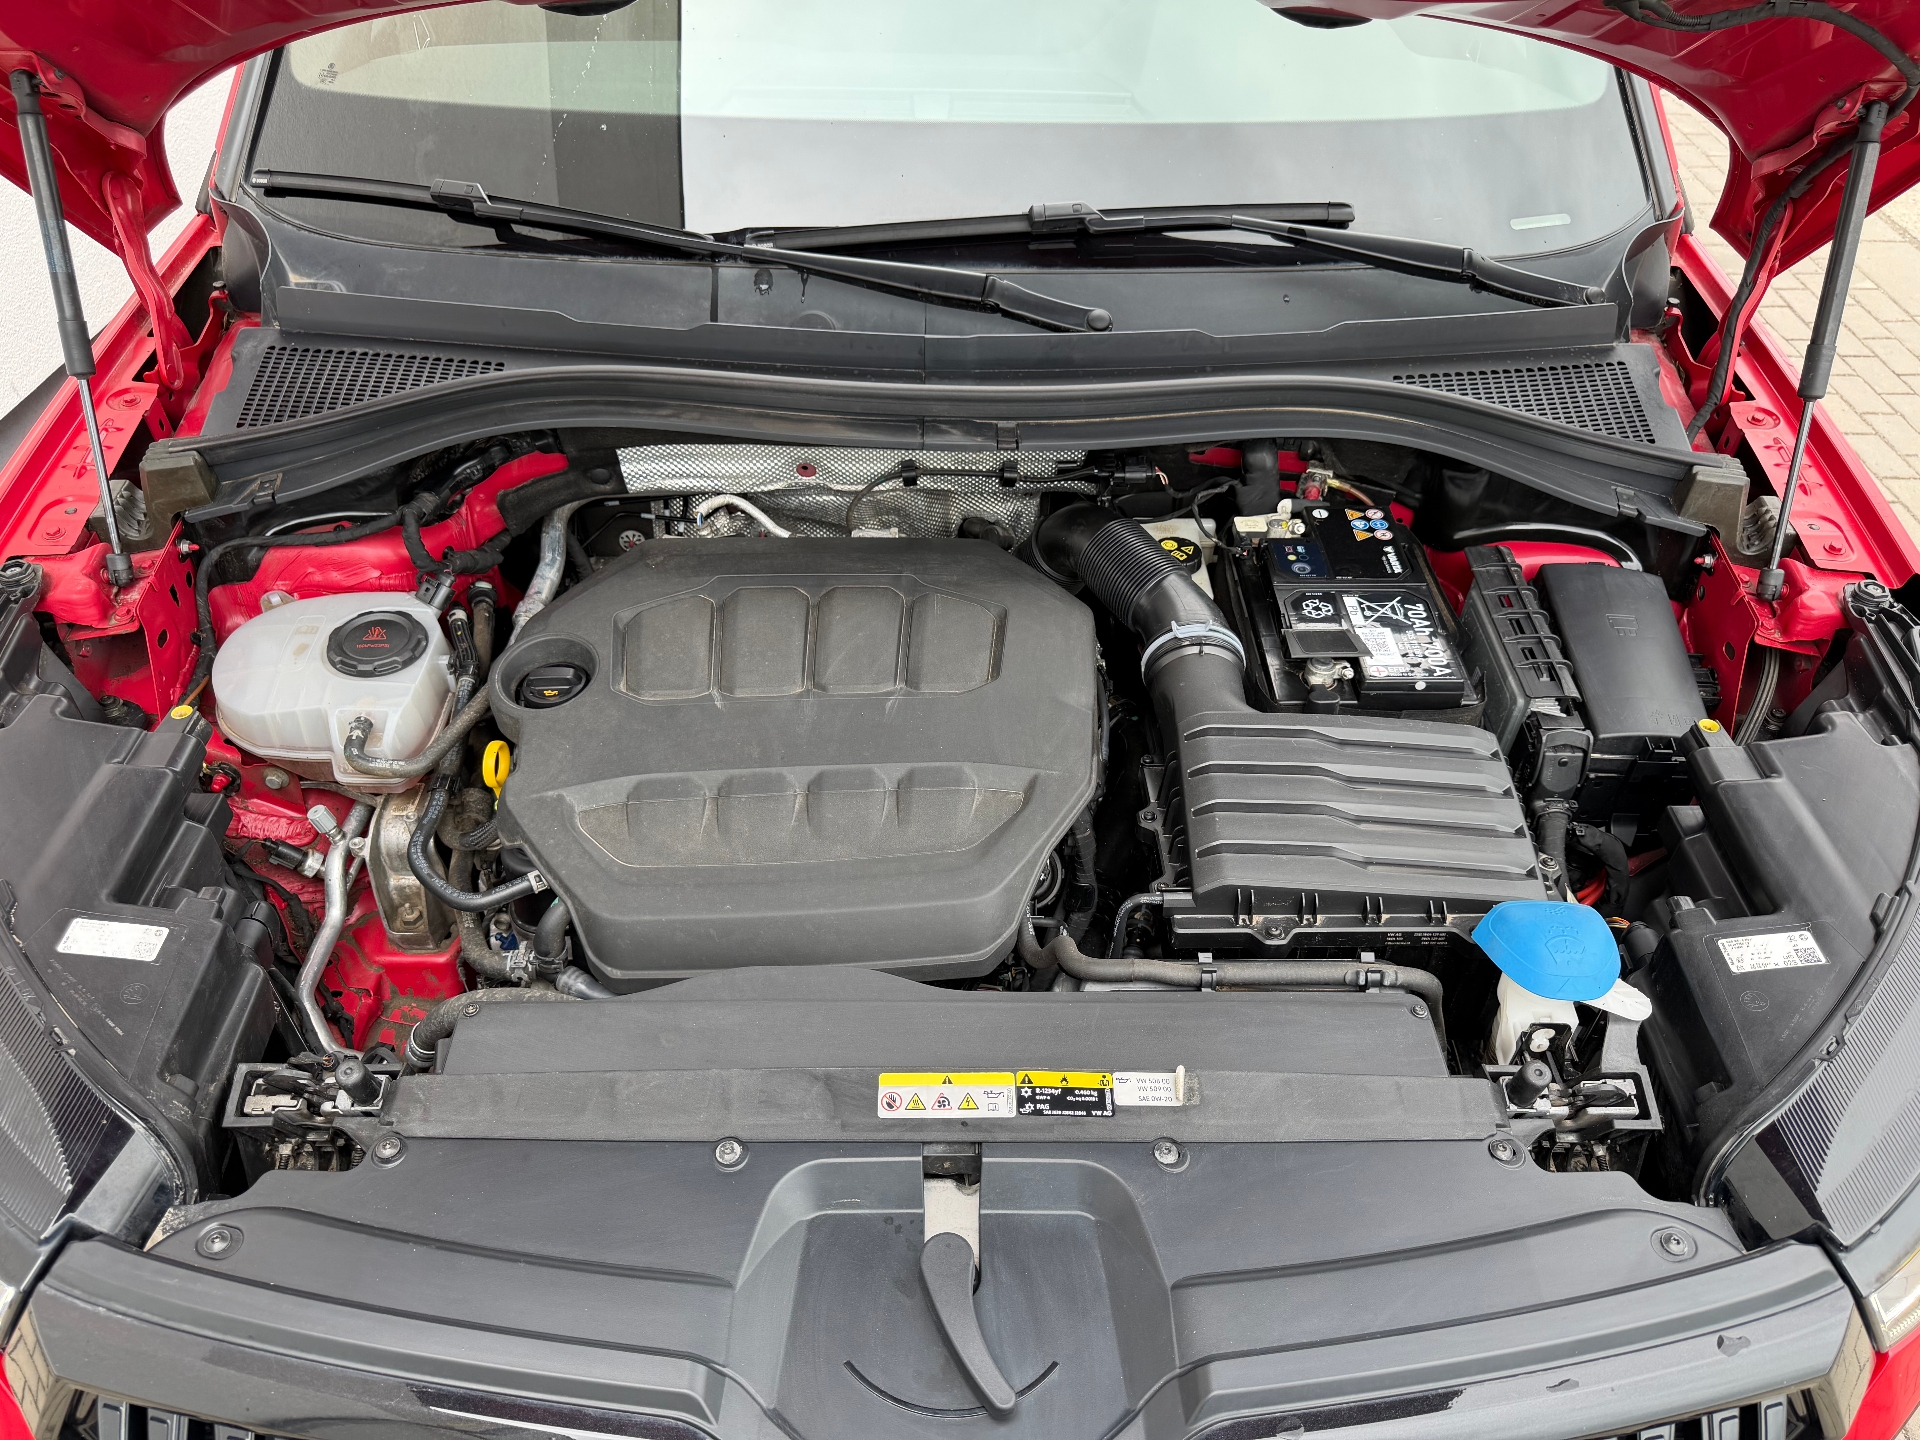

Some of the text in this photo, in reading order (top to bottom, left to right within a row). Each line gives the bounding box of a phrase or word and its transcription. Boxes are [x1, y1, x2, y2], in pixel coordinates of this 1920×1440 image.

[1387, 552, 1403, 574] VARTA
[1347, 605, 1359, 616] Pb
[1404, 603, 1434, 636] 70Ah
[1421, 642, 1452, 677] 700A
[1035, 1088, 1062, 1096] R-1234yf
